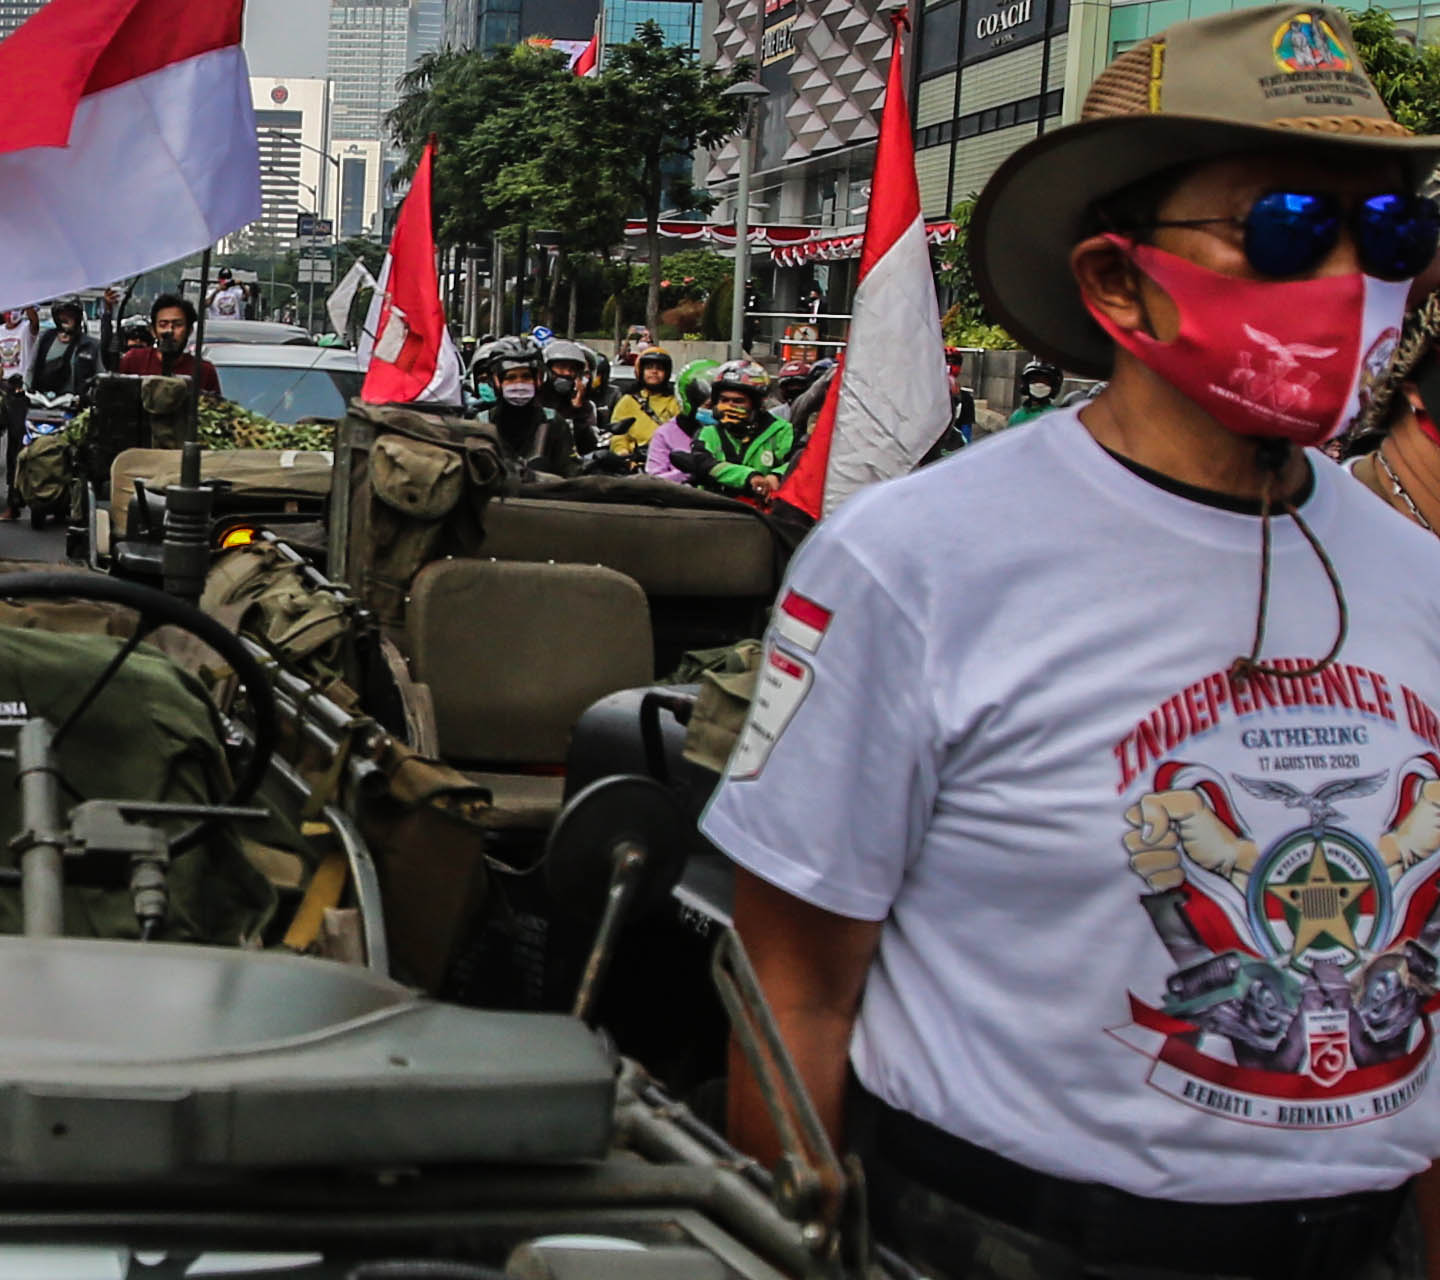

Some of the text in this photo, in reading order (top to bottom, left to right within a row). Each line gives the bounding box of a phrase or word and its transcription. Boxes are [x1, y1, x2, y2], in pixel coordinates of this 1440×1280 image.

[1114, 657, 1397, 796] INDEPENDENCE
[1241, 726, 1368, 751] GATHERING
[1259, 758, 1270, 771] 17
[1330, 754, 1360, 769] 2020
[1278, 1105, 1354, 1124] BERMAKNA
